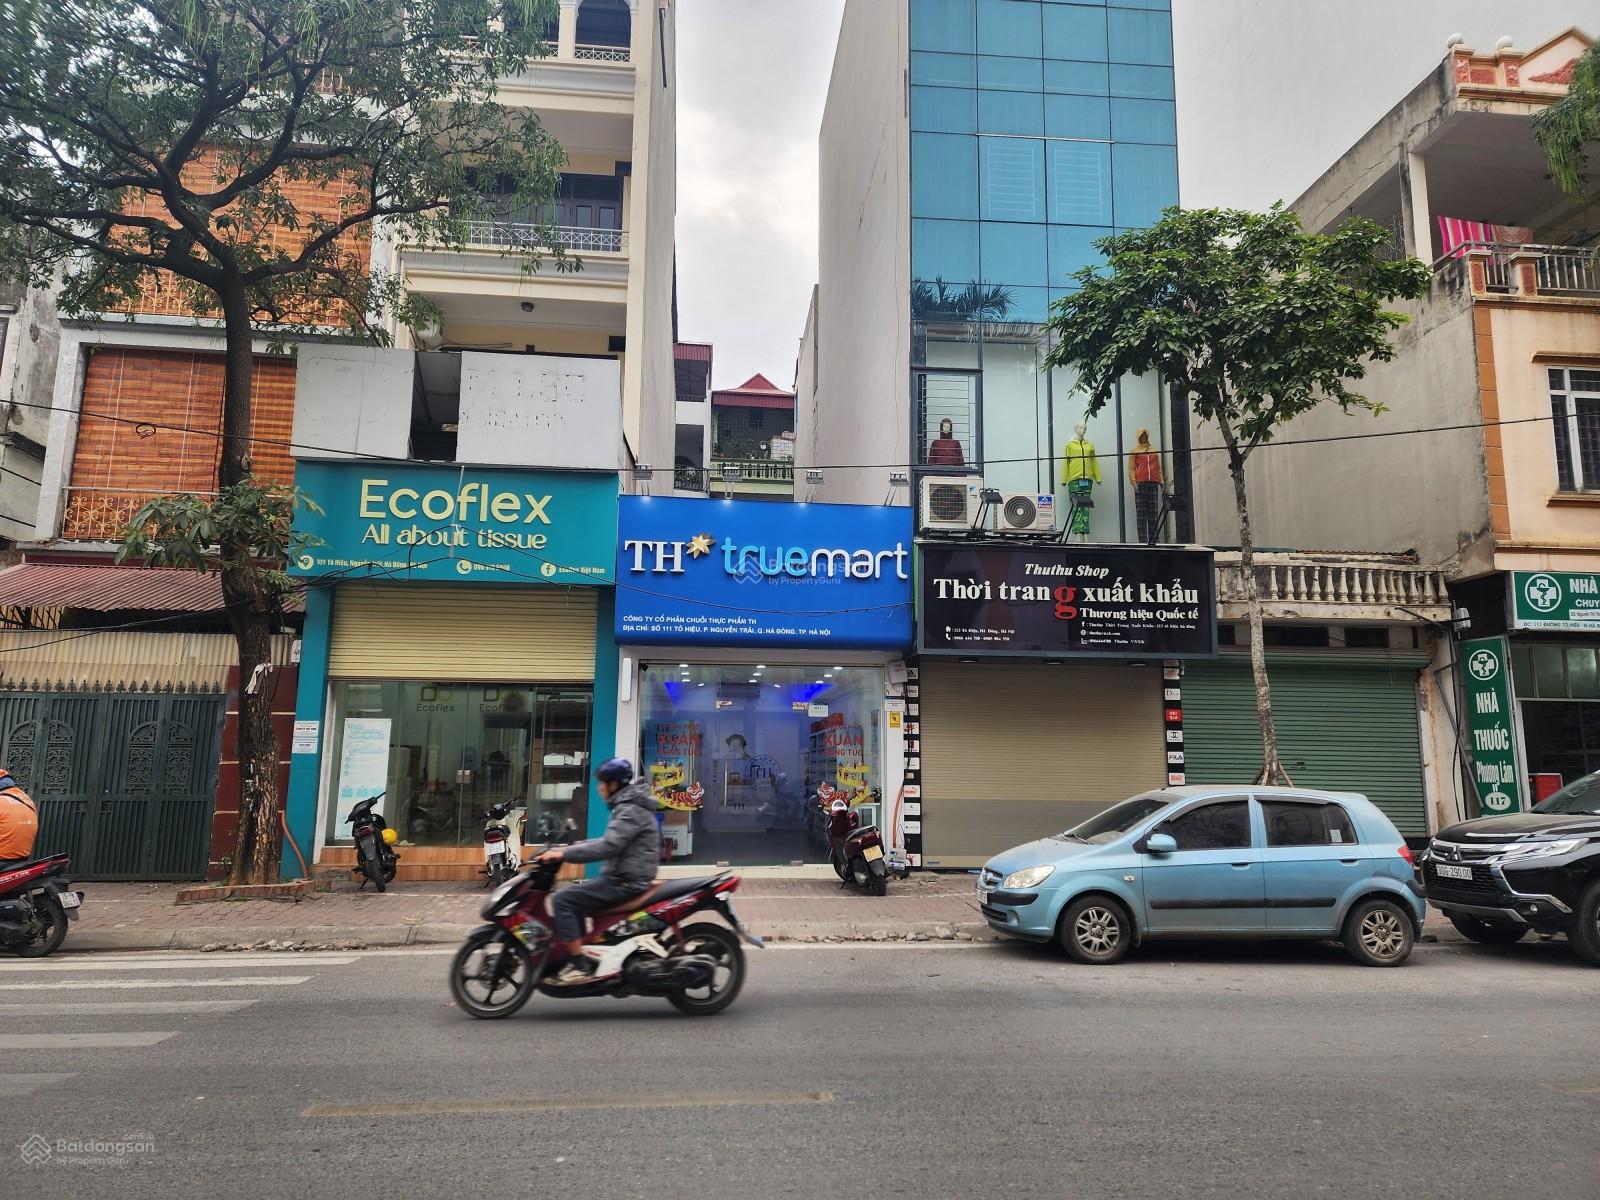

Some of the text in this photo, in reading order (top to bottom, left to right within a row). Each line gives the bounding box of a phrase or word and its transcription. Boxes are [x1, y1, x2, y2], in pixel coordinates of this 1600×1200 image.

[359, 479, 553, 525] Ecoflex
[361, 523, 548, 550] All about tissue
[624, 536, 909, 580] TH truemart
[1024, 563, 1110, 579] Thuthu Shop
[1569, 576, 1599, 594] NHÀ
[933, 576, 1199, 620] Thời trang xuất khẩu
[623, 614, 643, 622] CÔNG
[654, 614, 665, 623] CỔ
[708, 617, 727, 625] THỰC
[1079, 607, 1199, 622] Thương hiệu Quốc tế
[819, 628, 831, 636] NỘI
[416, 704, 455, 712] Ecoflex
[1475, 687, 1499, 714] NHÀ
[1473, 720, 1509, 751] THUỐC
[1475, 759, 1515, 786] Phương Lâm
[1489, 796, 1506, 806] 117
